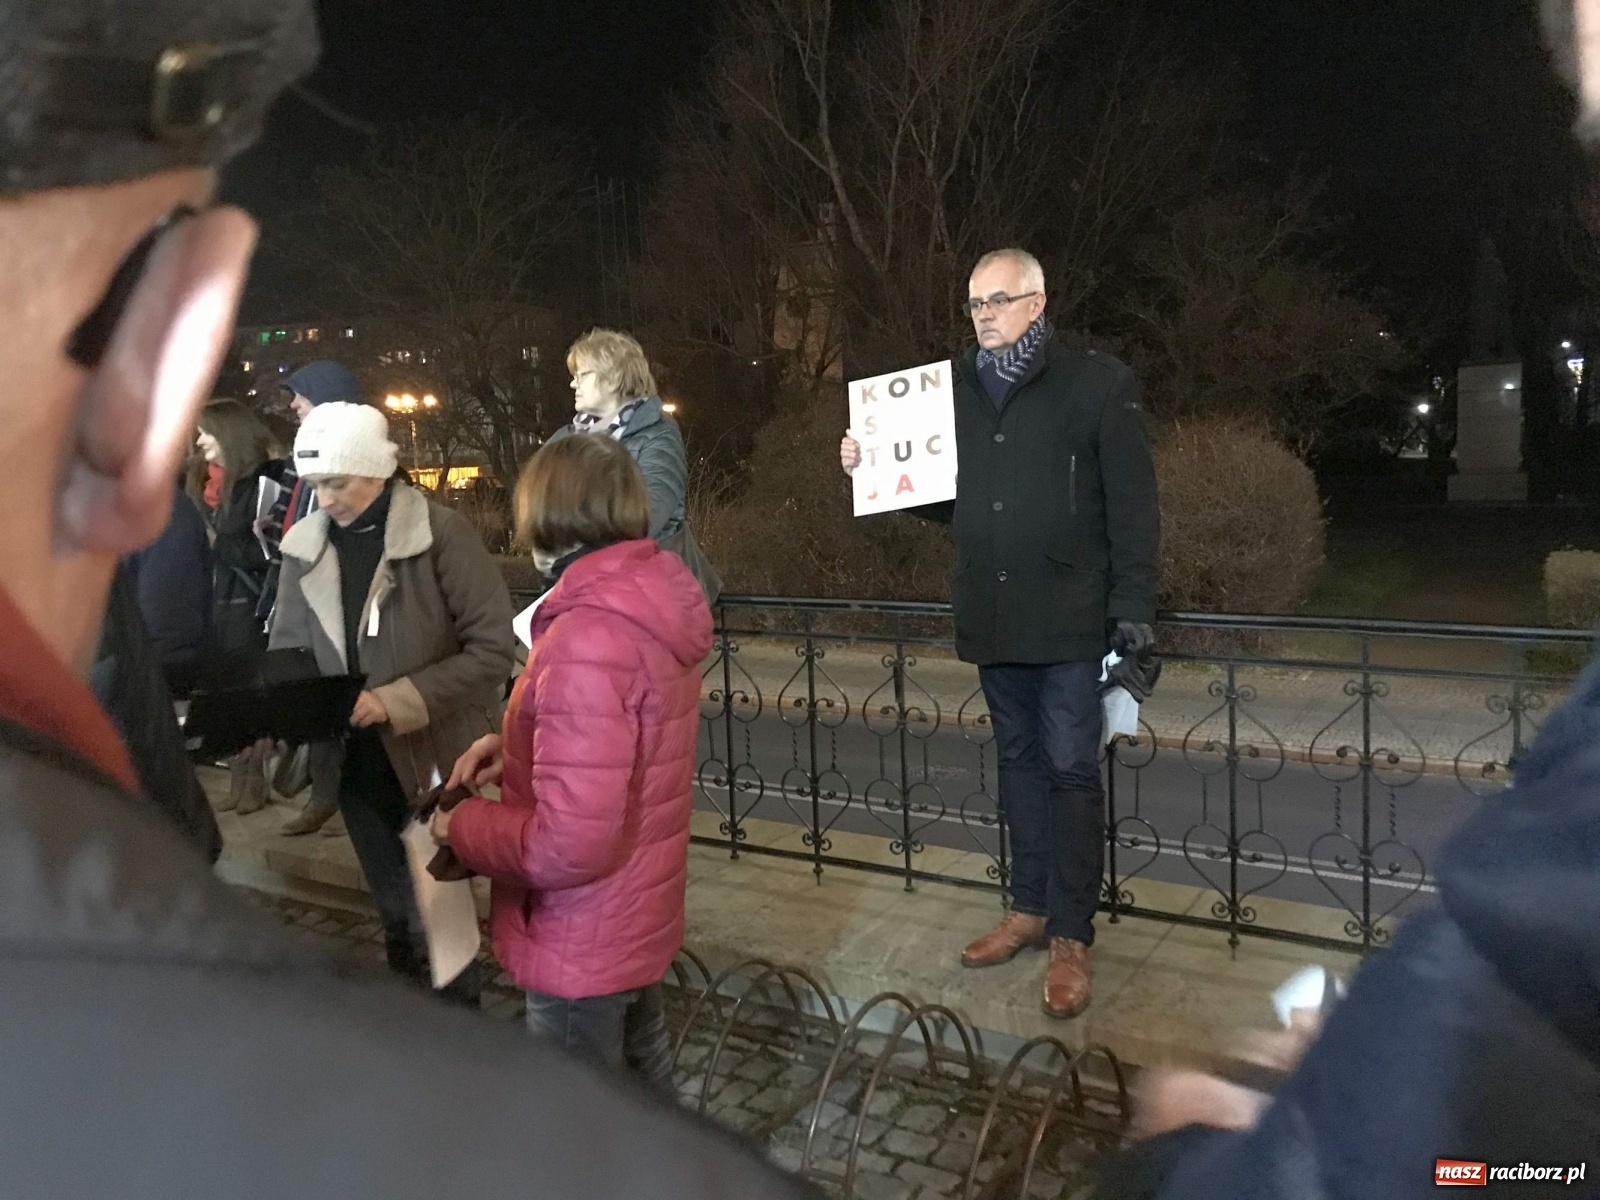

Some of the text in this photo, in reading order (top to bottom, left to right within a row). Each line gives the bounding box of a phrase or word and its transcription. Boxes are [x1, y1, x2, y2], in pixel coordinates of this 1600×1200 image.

[861, 369, 942, 404] KON
[866, 434, 942, 467] TUC
[867, 473, 915, 500] JA
